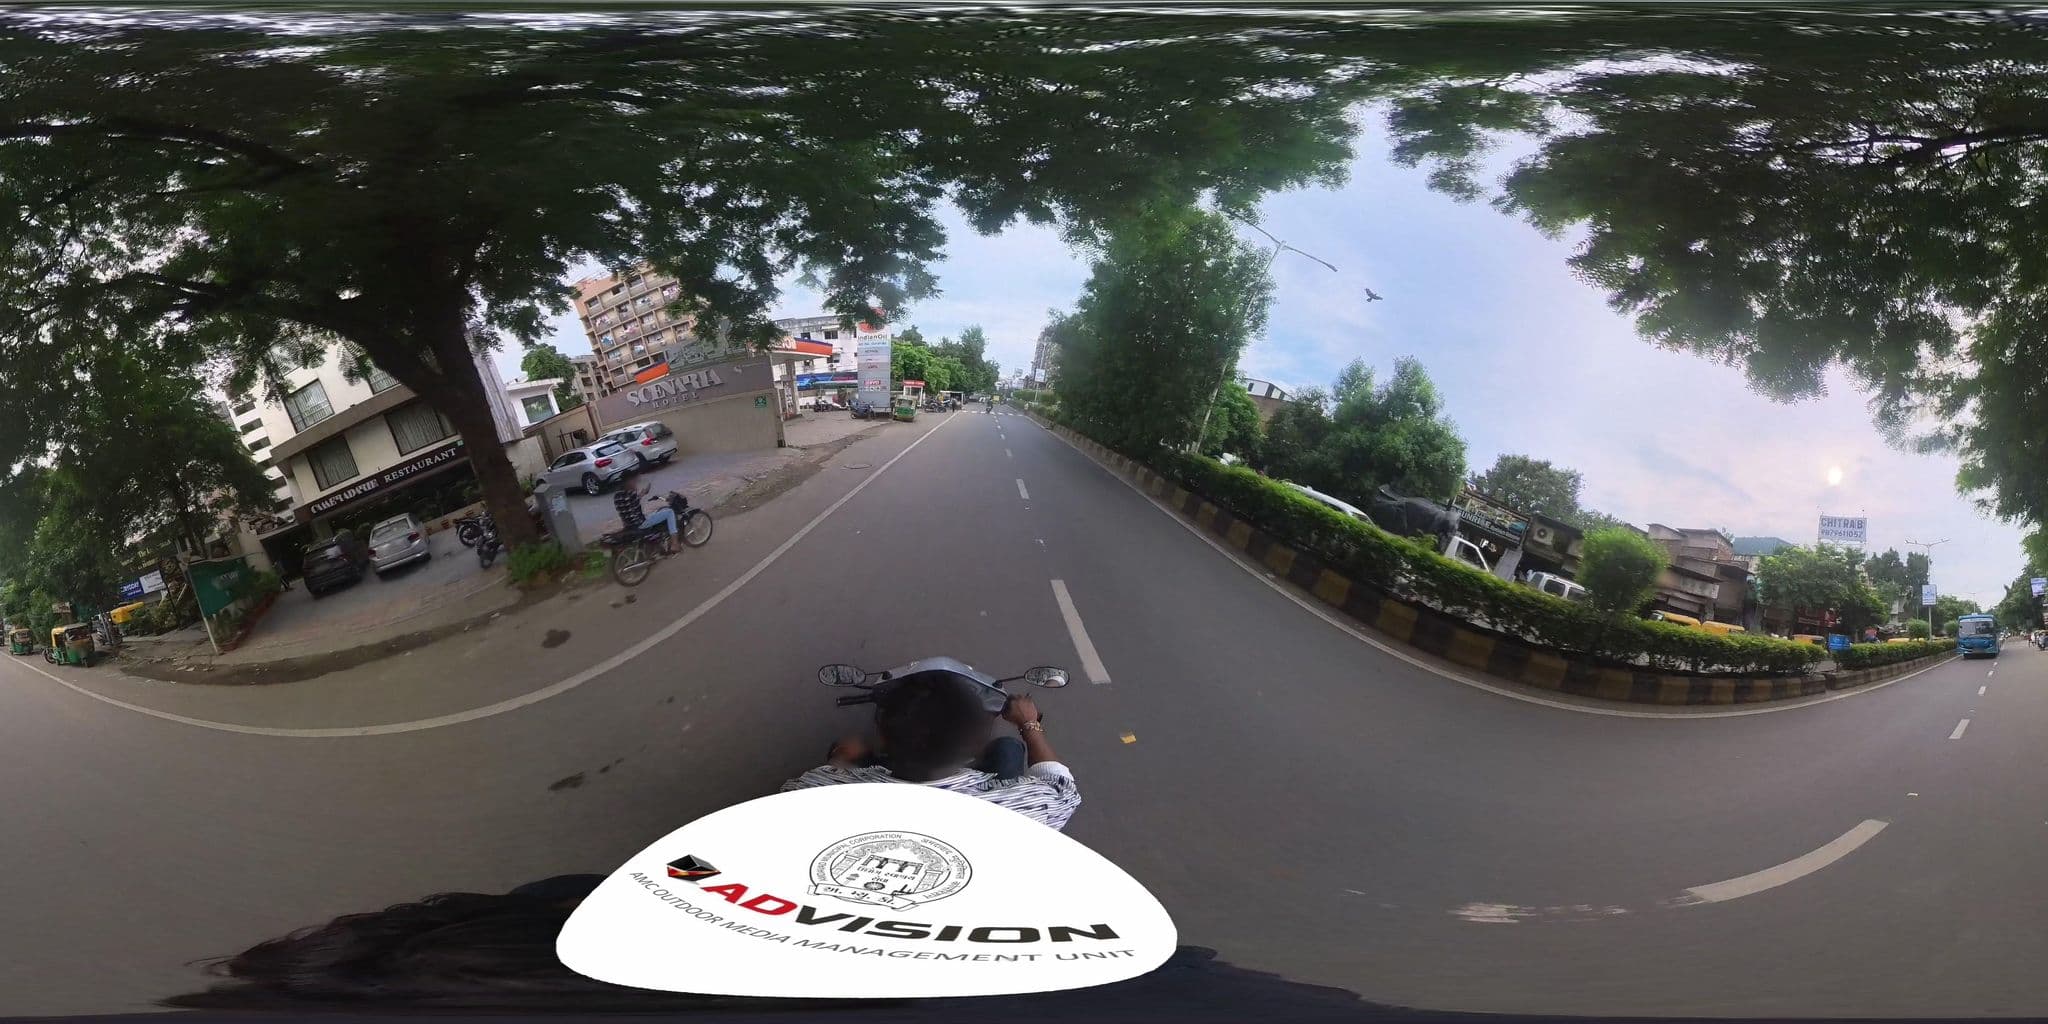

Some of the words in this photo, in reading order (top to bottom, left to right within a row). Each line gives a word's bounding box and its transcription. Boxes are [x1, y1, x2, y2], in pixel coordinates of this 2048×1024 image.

[626, 367, 723, 408] SCENARIA
[652, 391, 700, 409] HOTEL
[384, 448, 456, 483] RESTAURANT
